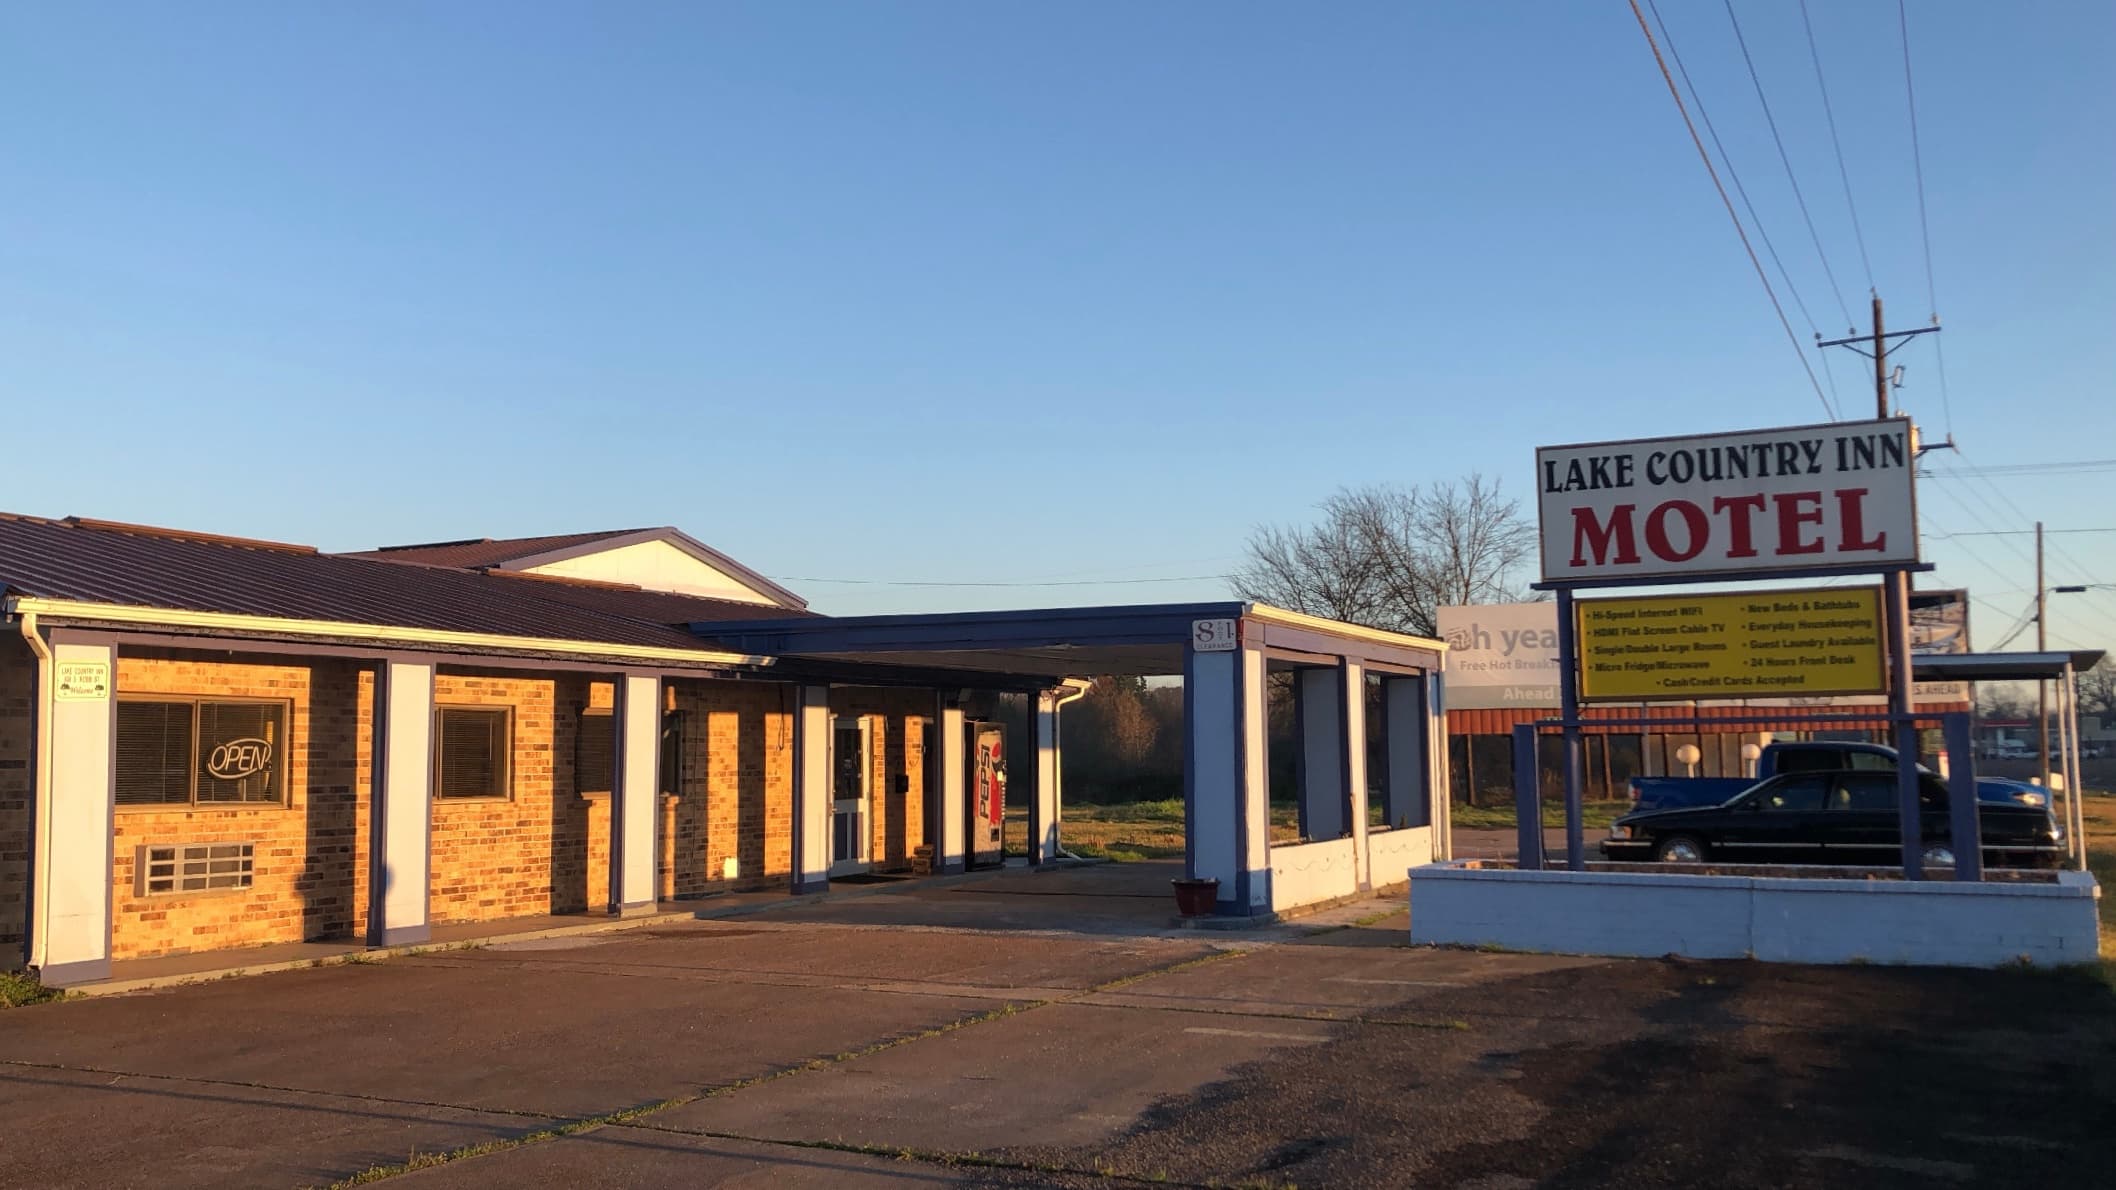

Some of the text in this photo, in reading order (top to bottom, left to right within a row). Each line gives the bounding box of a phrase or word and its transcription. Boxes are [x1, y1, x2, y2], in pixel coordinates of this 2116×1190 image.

[1545, 432, 1904, 493] LAKE COUNTRY INN
[1569, 487, 1886, 567] MOTEL
[1773, 603, 1799, 612] Beds
[1802, 602, 1810, 611] &
[1593, 610, 1635, 621] Hi-Speed
[1638, 608, 1677, 618] Internet
[1593, 624, 1725, 637] HDMI Flat Screen Cable TV
[1748, 619, 1872, 632] Everyday Housekeeping
[1500, 629, 1557, 656] yea
[1662, 643, 1690, 654] Large
[1693, 642, 1727, 651] Rooms
[1750, 636, 1875, 649] Guest Laundry Available
[1460, 660, 1487, 671] Free
[1489, 659, 1513, 671] Hot
[1595, 663, 1621, 672] Micro
[1750, 655, 1855, 667] 24 Hours Front Desk
[1723, 676, 1752, 686] Cards
[1756, 674, 1805, 686] Accepted
[1503, 687, 1554, 701] Ahead
[211, 745, 268, 771] OPEN
[979, 744, 991, 819] PEPSI
